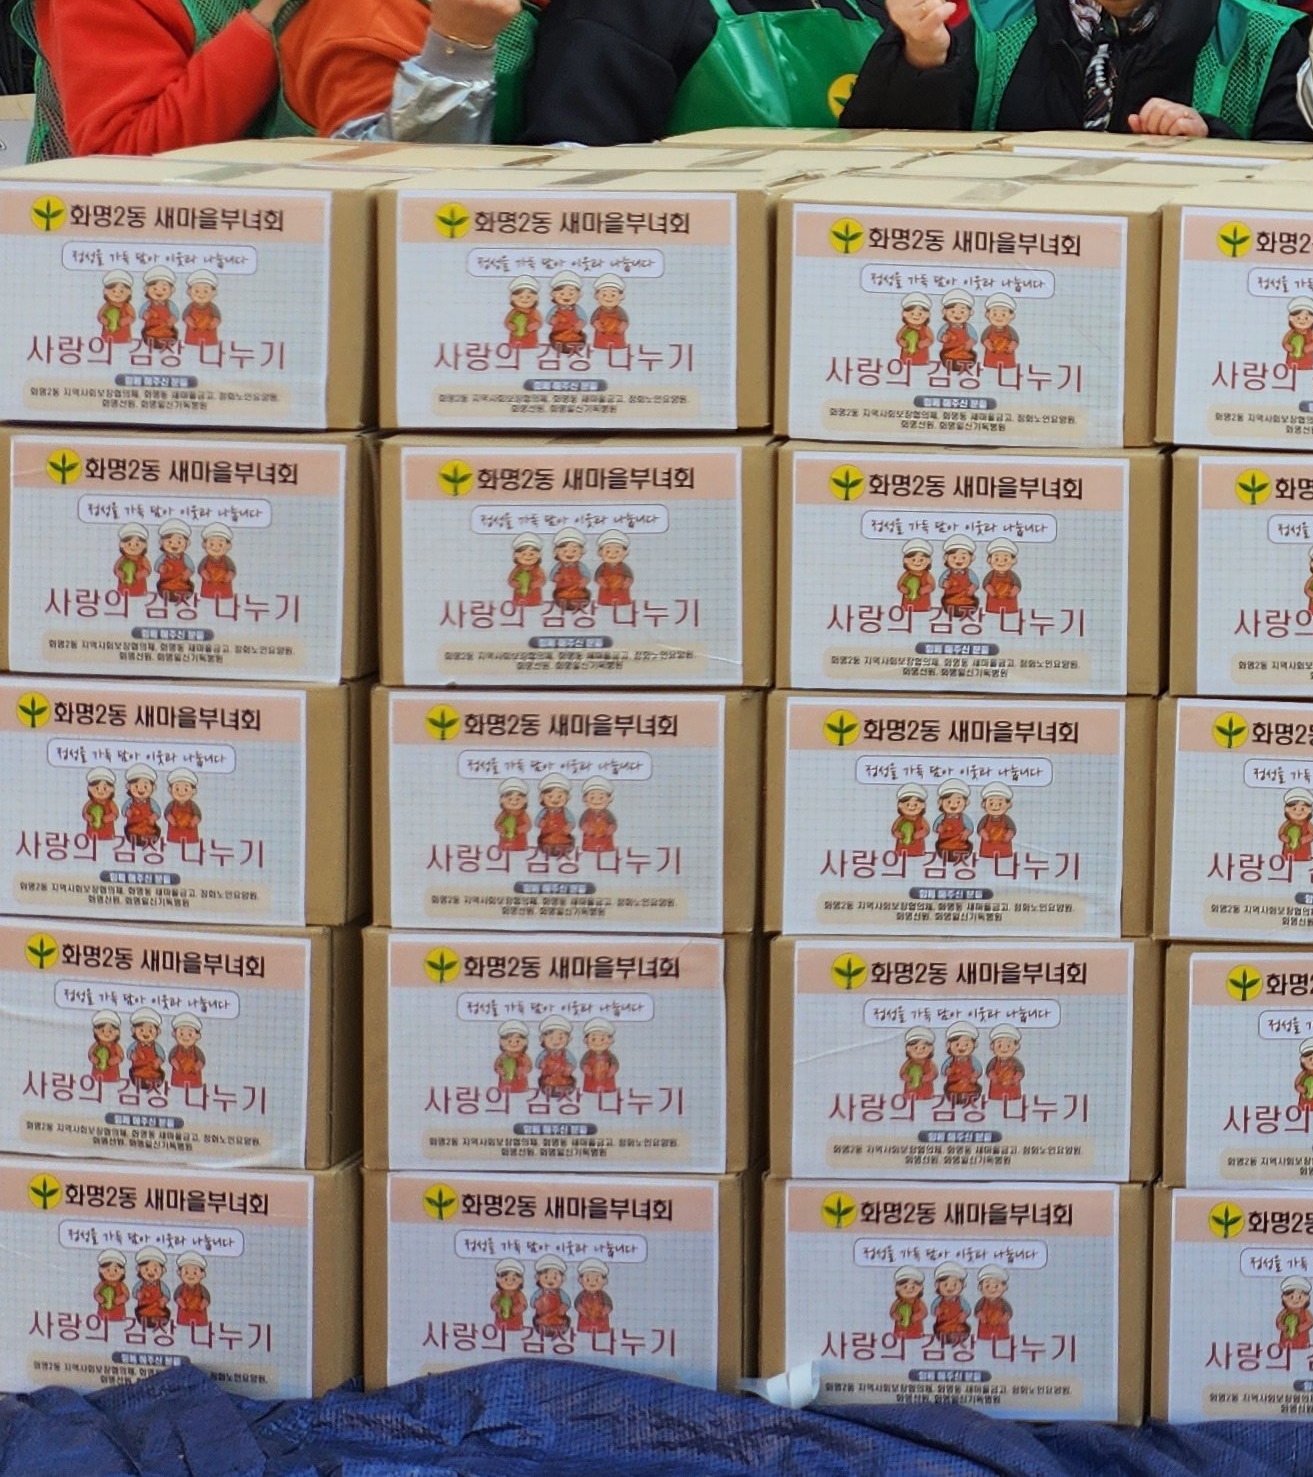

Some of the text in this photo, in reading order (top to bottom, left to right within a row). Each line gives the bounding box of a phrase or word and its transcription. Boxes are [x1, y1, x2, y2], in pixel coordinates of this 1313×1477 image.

[69, 204, 284, 233] 화명2동 새마을부녀회
[868, 227, 1082, 258] 화명2동 새마을부녀회
[26, 334, 285, 371] 사랑의 김장 나누기
[825, 356, 1083, 394] 사랑의 김장 나누기
[476, 467, 695, 491] 화명2동 새마을부녀회
[437, 599, 700, 629] 사랑의 김장 나누기
[53, 701, 261, 733] 화명2동 새마을부녀회
[1206, 851, 1294, 884] 사랑의
[463, 955, 680, 980] 화명2동 새마을부녀회
[423, 1086, 684, 1117] 사랑의 김장 나누기
[65, 1183, 269, 1217] 화명2동 새마을부녀회
[860, 1201, 1073, 1227] 화명2동 새마을부녀회
